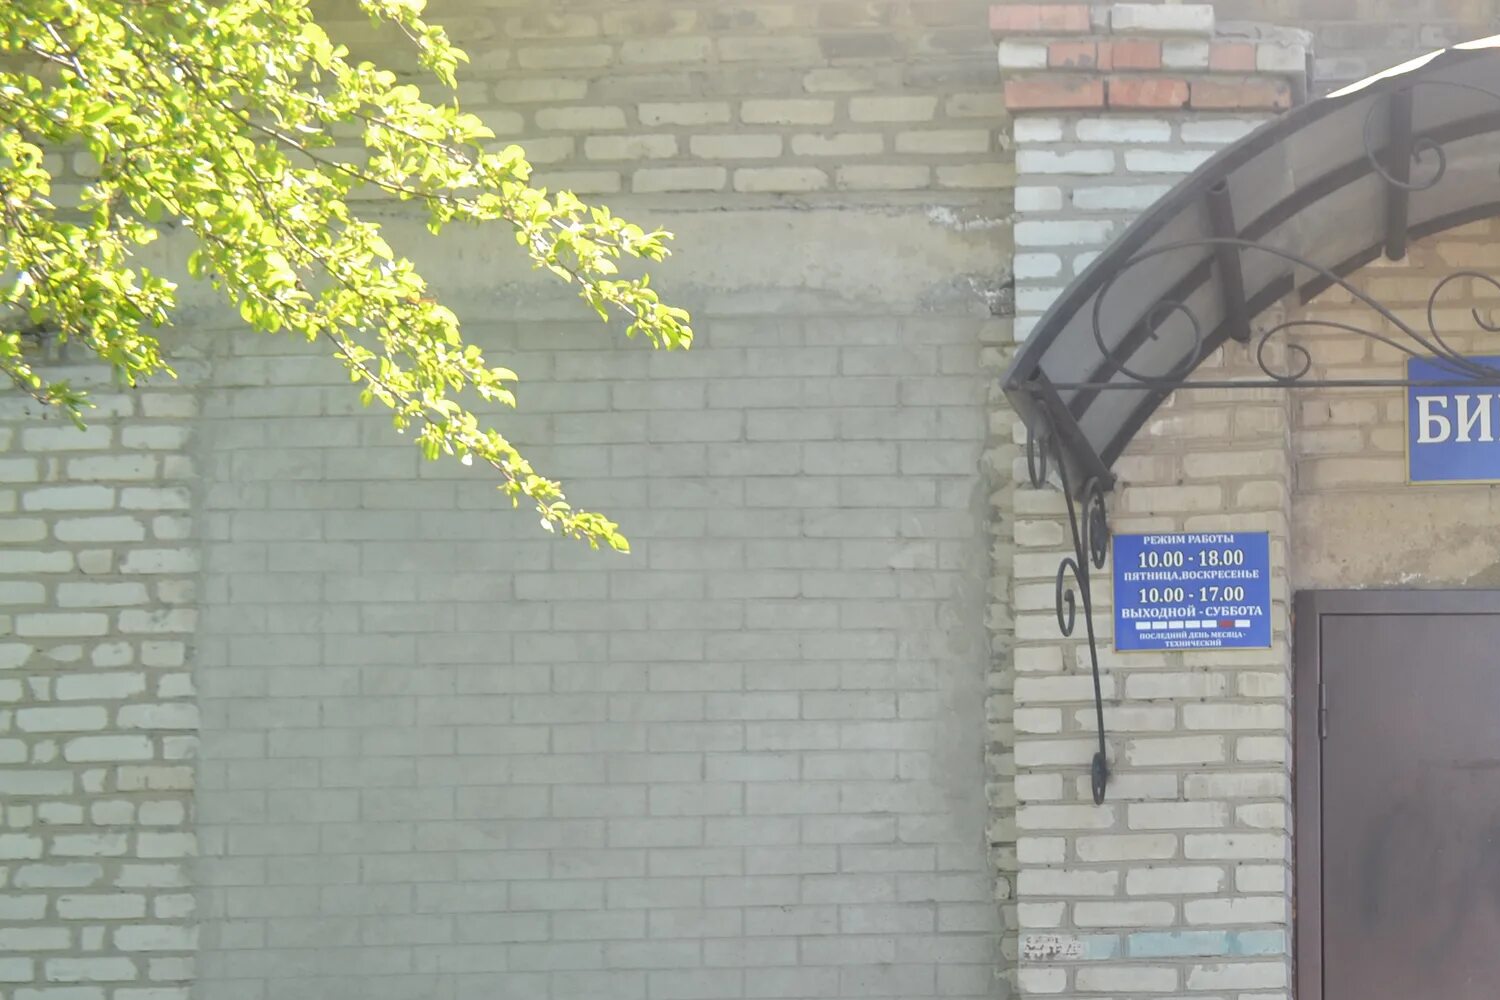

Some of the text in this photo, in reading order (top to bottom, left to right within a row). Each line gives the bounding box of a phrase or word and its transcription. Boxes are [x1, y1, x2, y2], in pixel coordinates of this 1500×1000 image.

[1143, 534, 1234, 545] РЕЖИМ РАБОТЫ
[1138, 551, 1184, 568] 10.00
[1198, 549, 1244, 566] 18.00
[1139, 587, 1184, 603] 10.00
[1199, 586, 1244, 602] 17.00
[1121, 604, 1196, 619] ВЫХОДНОЙ
[1205, 605, 1263, 616] СУББОТА
